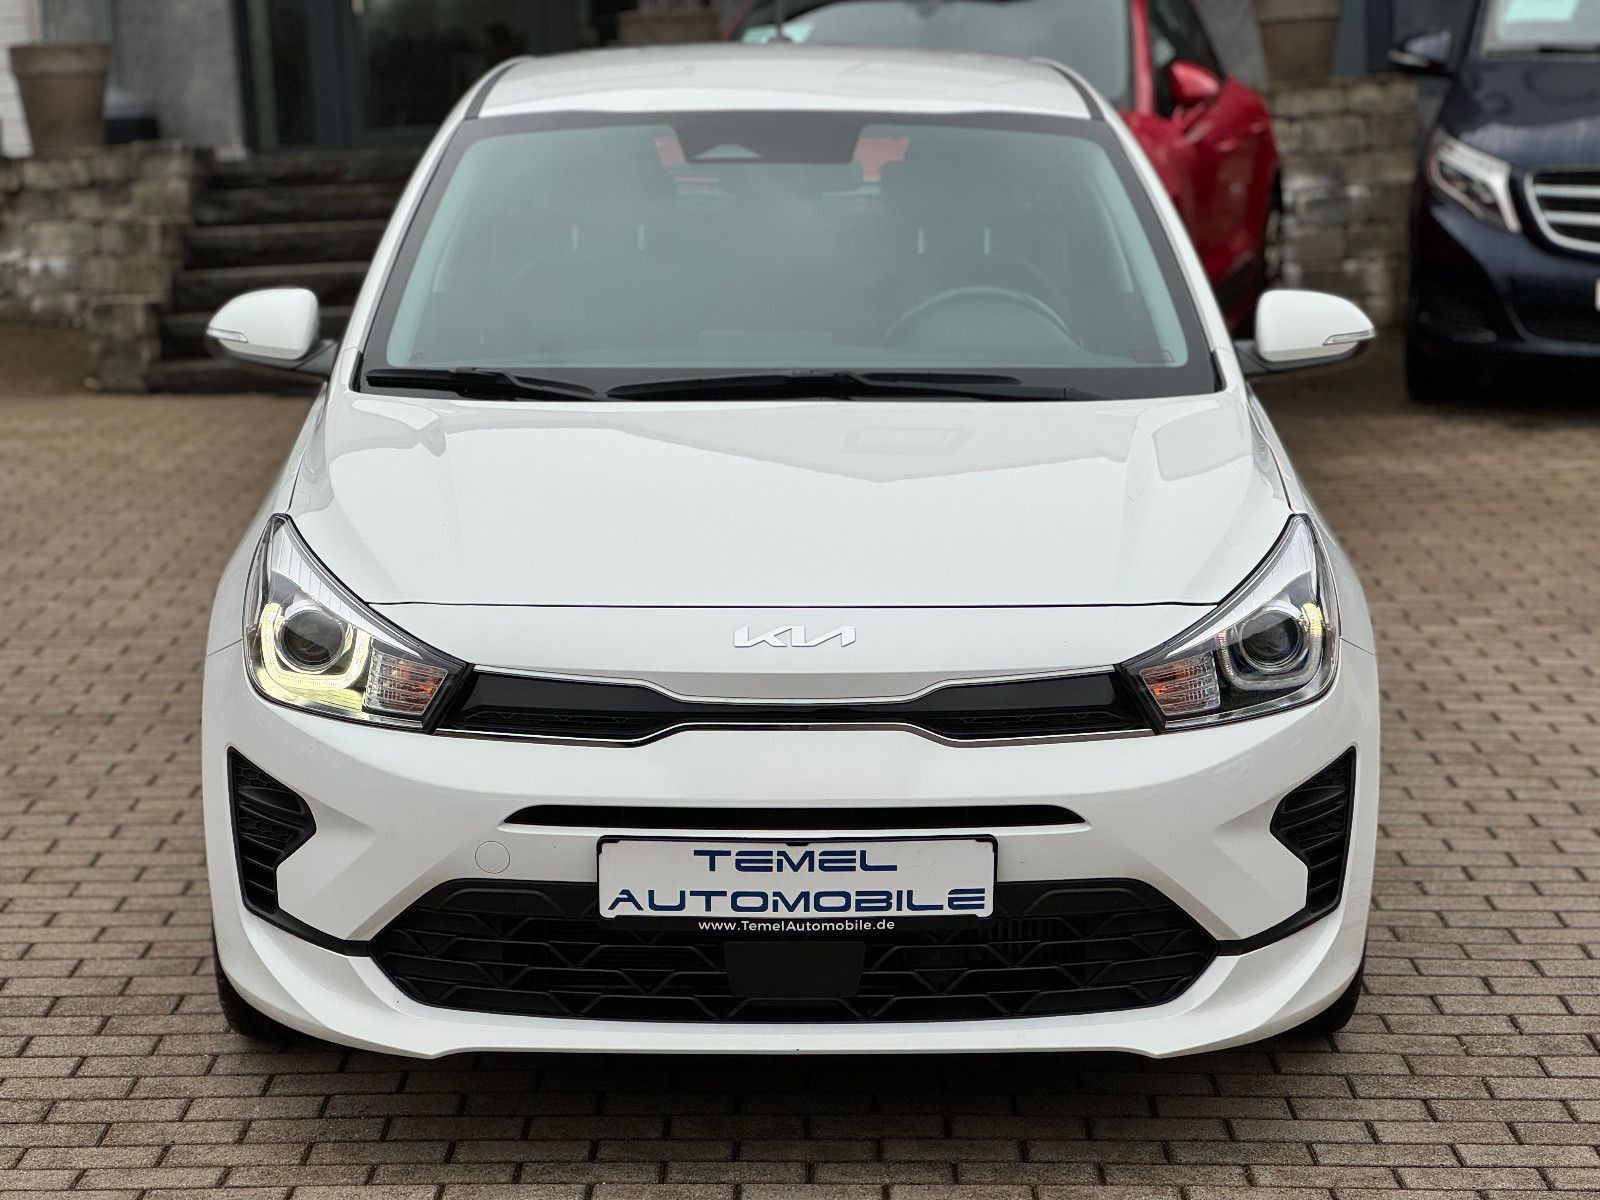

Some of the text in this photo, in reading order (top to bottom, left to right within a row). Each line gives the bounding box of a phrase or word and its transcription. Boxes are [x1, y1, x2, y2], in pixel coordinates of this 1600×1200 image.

[733, 625, 856, 648] KIA
[694, 849, 898, 872] TEMEL
[608, 888, 986, 912] AUTOMOBILE
[698, 919, 895, 931] www.TemelAutomobile.de
